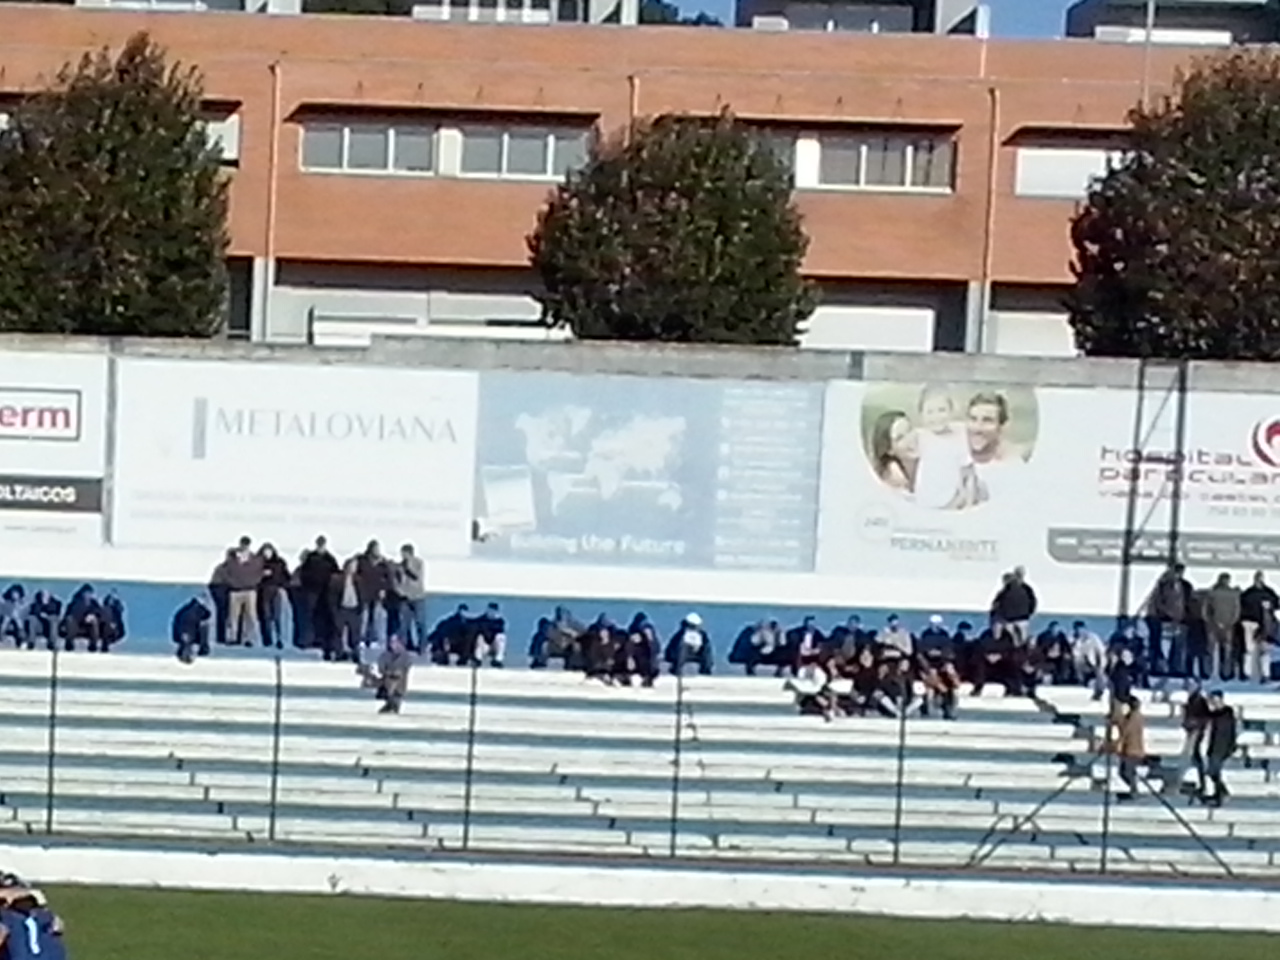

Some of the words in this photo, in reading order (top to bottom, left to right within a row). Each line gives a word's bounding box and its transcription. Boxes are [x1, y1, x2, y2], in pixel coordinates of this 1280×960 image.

[215, 406, 459, 444] METALOVIANA
[1100, 445, 1253, 467] hoital
[24, 916, 41, 955] 1
